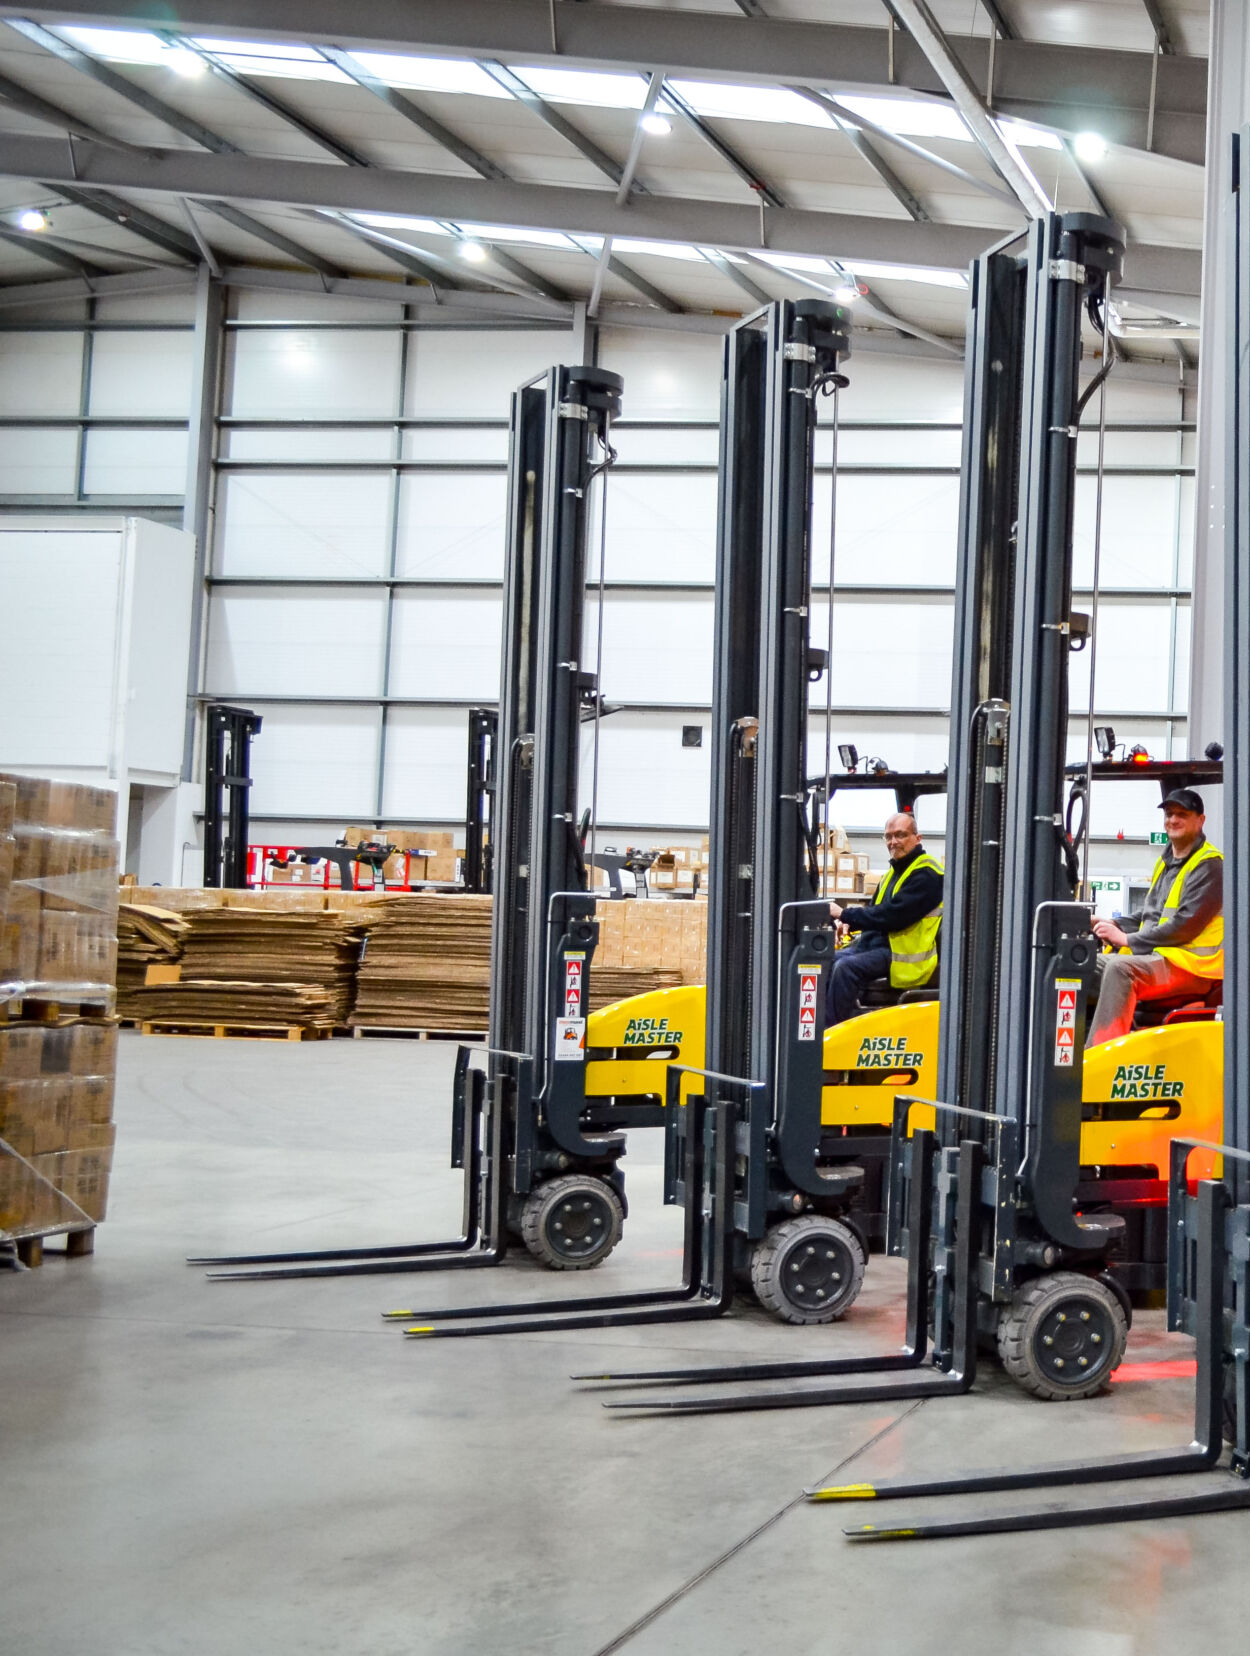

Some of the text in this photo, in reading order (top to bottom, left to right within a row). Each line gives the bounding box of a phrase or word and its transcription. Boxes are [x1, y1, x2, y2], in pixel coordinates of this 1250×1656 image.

[624, 1031, 683, 1045] MASTER
[859, 1037, 907, 1051] AiSLE
[856, 1053, 923, 1067] MASTER
[1113, 1064, 1166, 1081] AiSLE
[1110, 1081, 1184, 1099] MASTER
